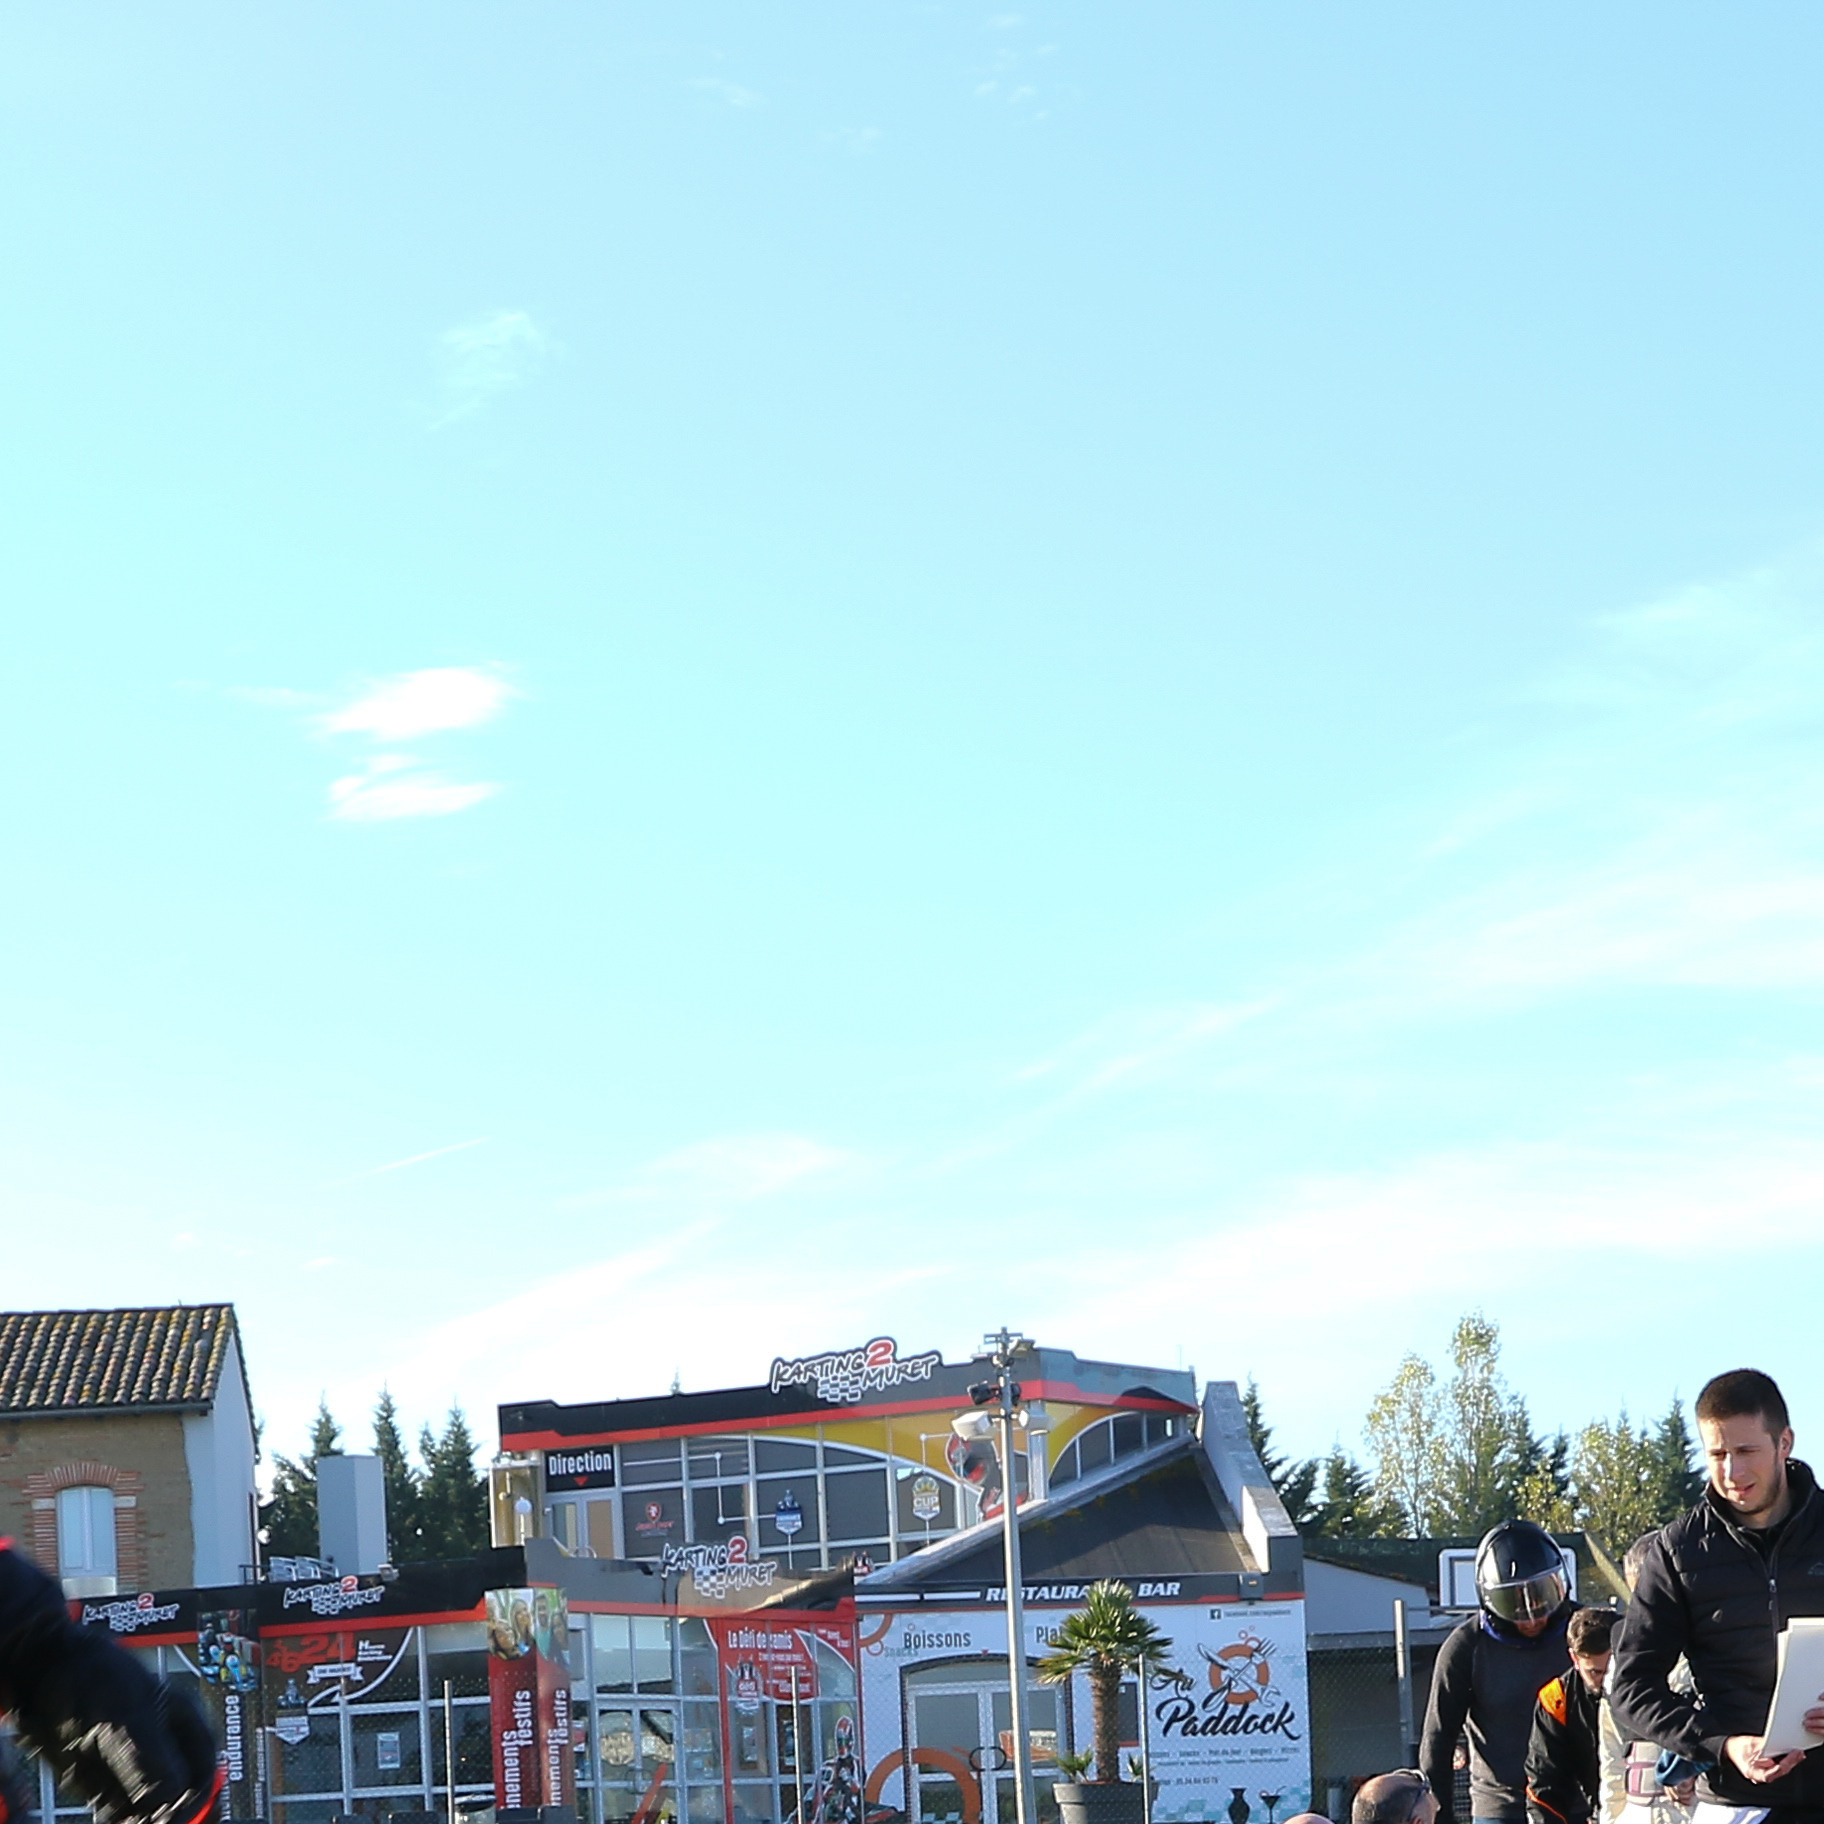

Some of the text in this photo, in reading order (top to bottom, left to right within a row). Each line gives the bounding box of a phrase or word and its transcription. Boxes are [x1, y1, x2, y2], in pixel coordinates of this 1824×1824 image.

[771, 1339, 939, 1393] KARTING 2 MURET
[548, 1450, 613, 1476] Direction
[913, 1496, 939, 1507] CUP
[661, 1535, 777, 1591] KARTING 2 MURET
[138, 1593, 154, 1610] 2
[283, 1582, 341, 1608] KARTING
[340, 1575, 359, 1593] 2
[1138, 1582, 1181, 1597] BAR
[903, 1630, 971, 1649] Boissons
[512, 1690, 533, 1746] festifs
[554, 1689, 569, 1744] festifs
[1156, 1697, 1301, 1740] Paddock
[225, 1695, 244, 1781] endurance
